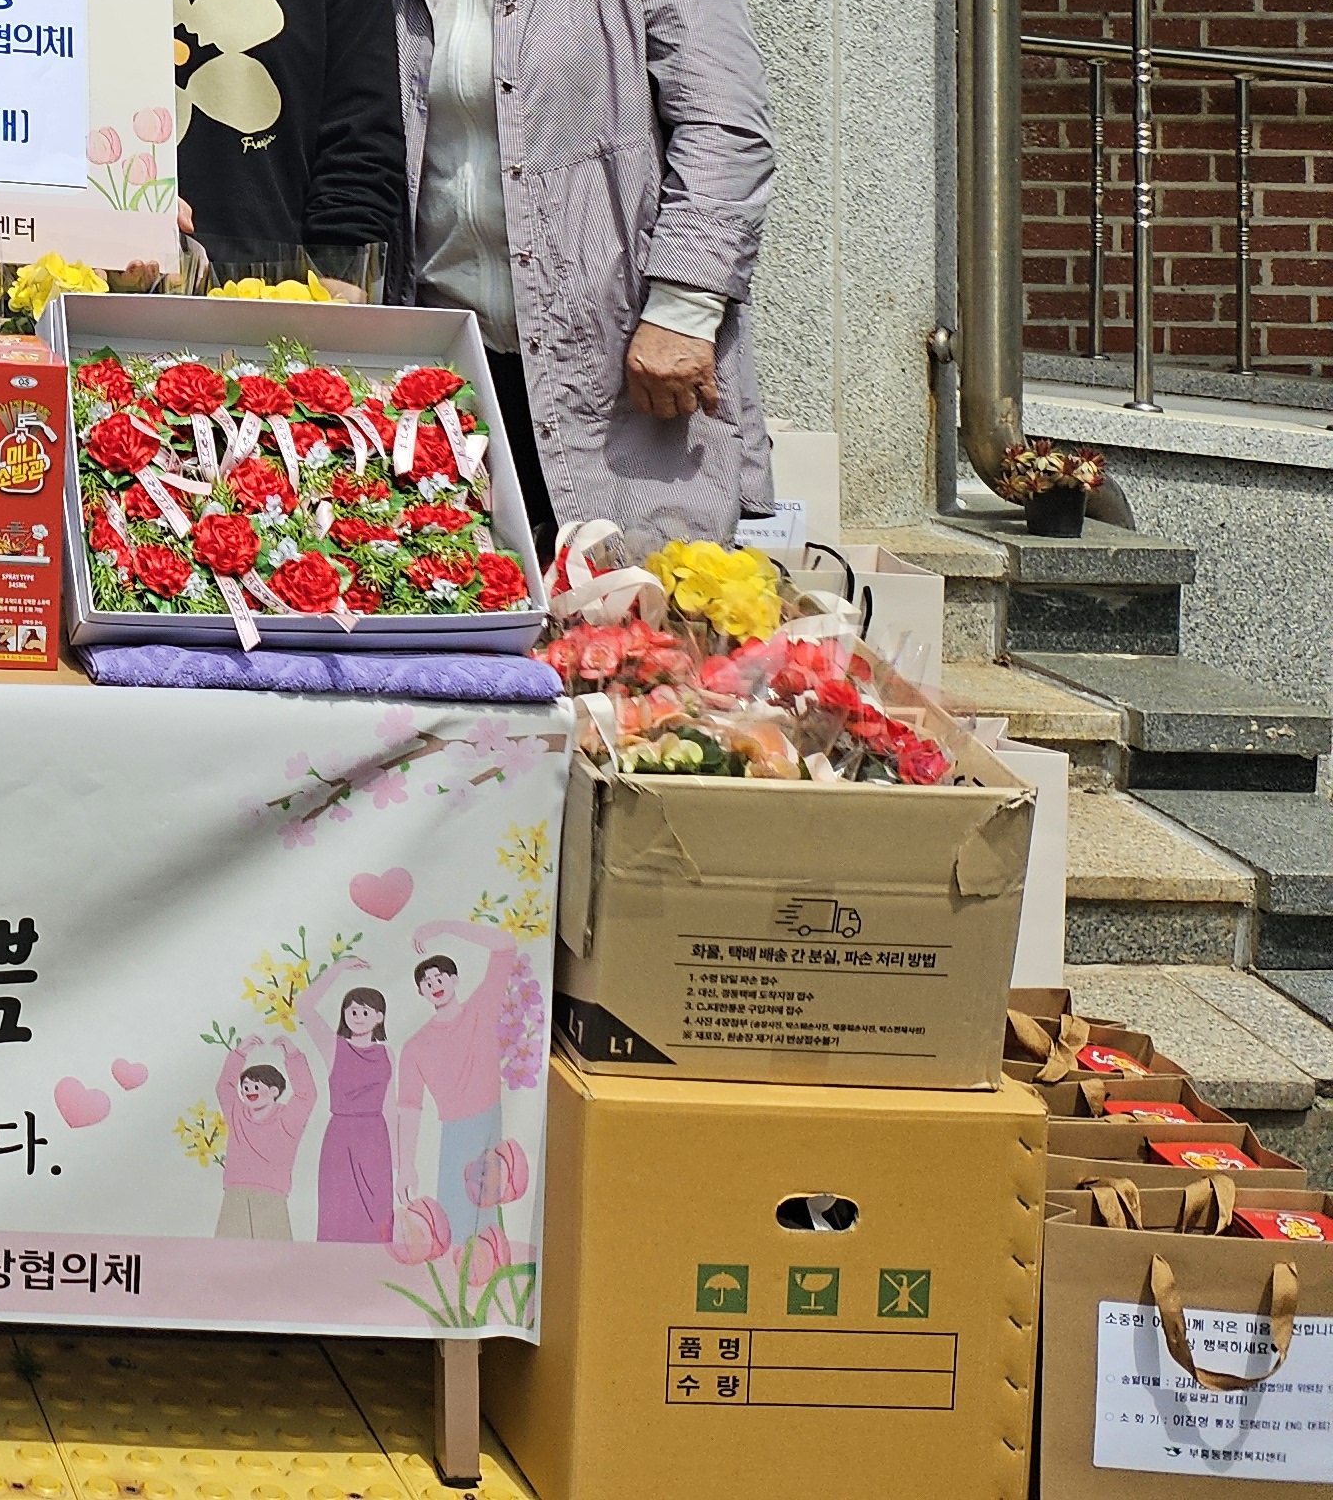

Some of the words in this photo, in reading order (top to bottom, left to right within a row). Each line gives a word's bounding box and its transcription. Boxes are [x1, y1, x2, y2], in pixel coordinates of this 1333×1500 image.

[6, 441, 38, 464] 미니
[792, 948, 805, 964] 간
[844, 950, 872, 967] 파손
[876, 951, 904, 967] 처리
[908, 953, 936, 968] 방법
[610, 1037, 633, 1055] L1
[1105, 1312, 1145, 1327] 소중한
[1213, 1320, 1238, 1334] 작은
[677, 1337, 702, 1360] 품
[717, 1337, 741, 1361] 명
[1203, 1339, 1269, 1355] 행복하세요
[676, 1374, 701, 1397] 수
[716, 1373, 740, 1398] 량
